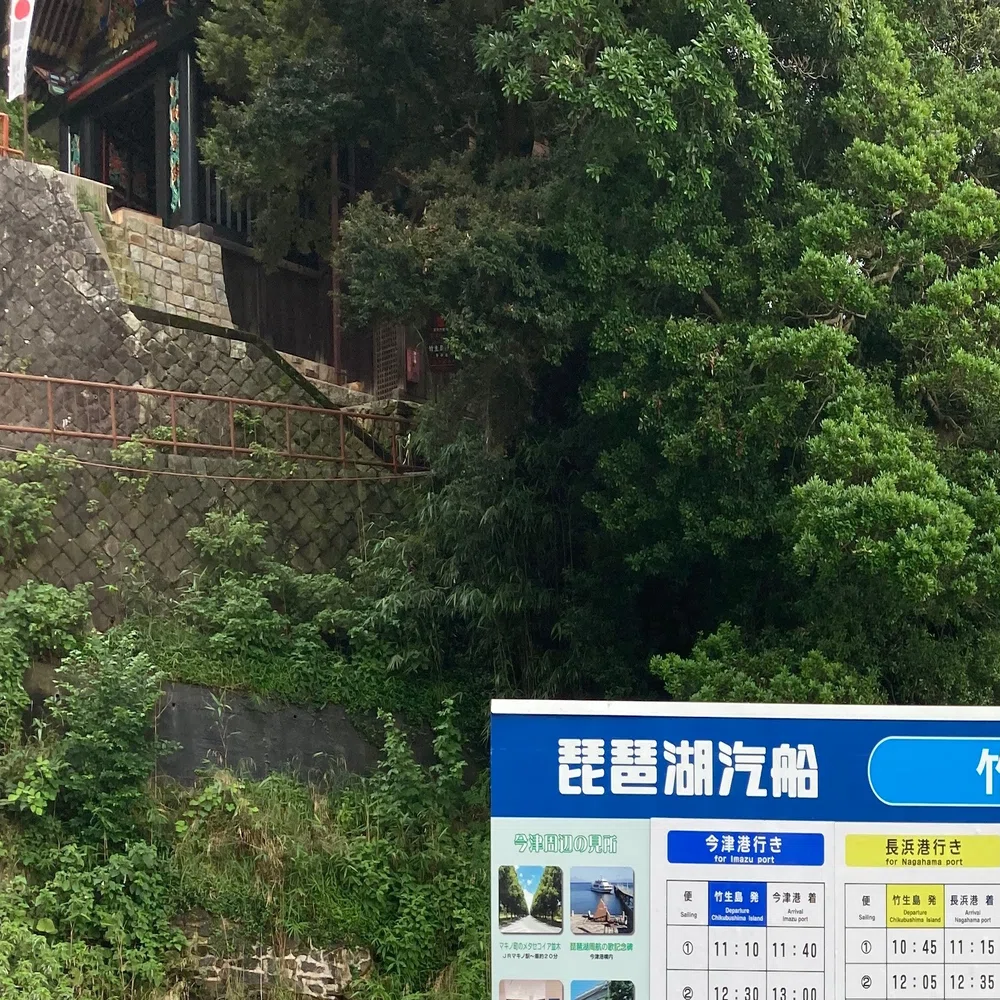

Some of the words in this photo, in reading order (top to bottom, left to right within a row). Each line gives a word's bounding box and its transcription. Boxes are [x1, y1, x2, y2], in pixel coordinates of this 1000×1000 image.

[558, 738, 819, 798] 琵琶湖汽船
[514, 833, 617, 854] 今津周辺の見所
[705, 834, 782, 853] 今津港行き
[885, 839, 962, 856] 長浜港行き
[714, 855, 727, 863] for
[730, 855, 754, 863] Imazu
[758, 856, 775, 864] port
[885, 858, 898, 866] for
[902, 858, 942, 866] Nagahama
[945, 858, 963, 867] port
[683, 891, 693, 902] 便
[714, 891, 743, 903] 竹生島
[750, 891, 759, 903] 発
[772, 892, 801, 903] 今津港
[808, 892, 817, 903] 着
[862, 895, 870, 906] 便
[892, 895, 921, 906] 竹生島
[928, 895, 937, 906] 発
[950, 895, 978, 906] 長浜港
[985, 895, 994, 906] 着
[680, 911, 698, 919] Sailing
[725, 907, 750, 915] Departure
[714, 941, 759, 956] 11:10
[772, 942, 817, 957] 11:40
[892, 940, 937, 955] 10:45
[950, 940, 995, 955] 11:15
[892, 975, 937, 990] 12:05
[950, 975, 995, 990] 12:35
[714, 986, 759, 1000] 12:30
